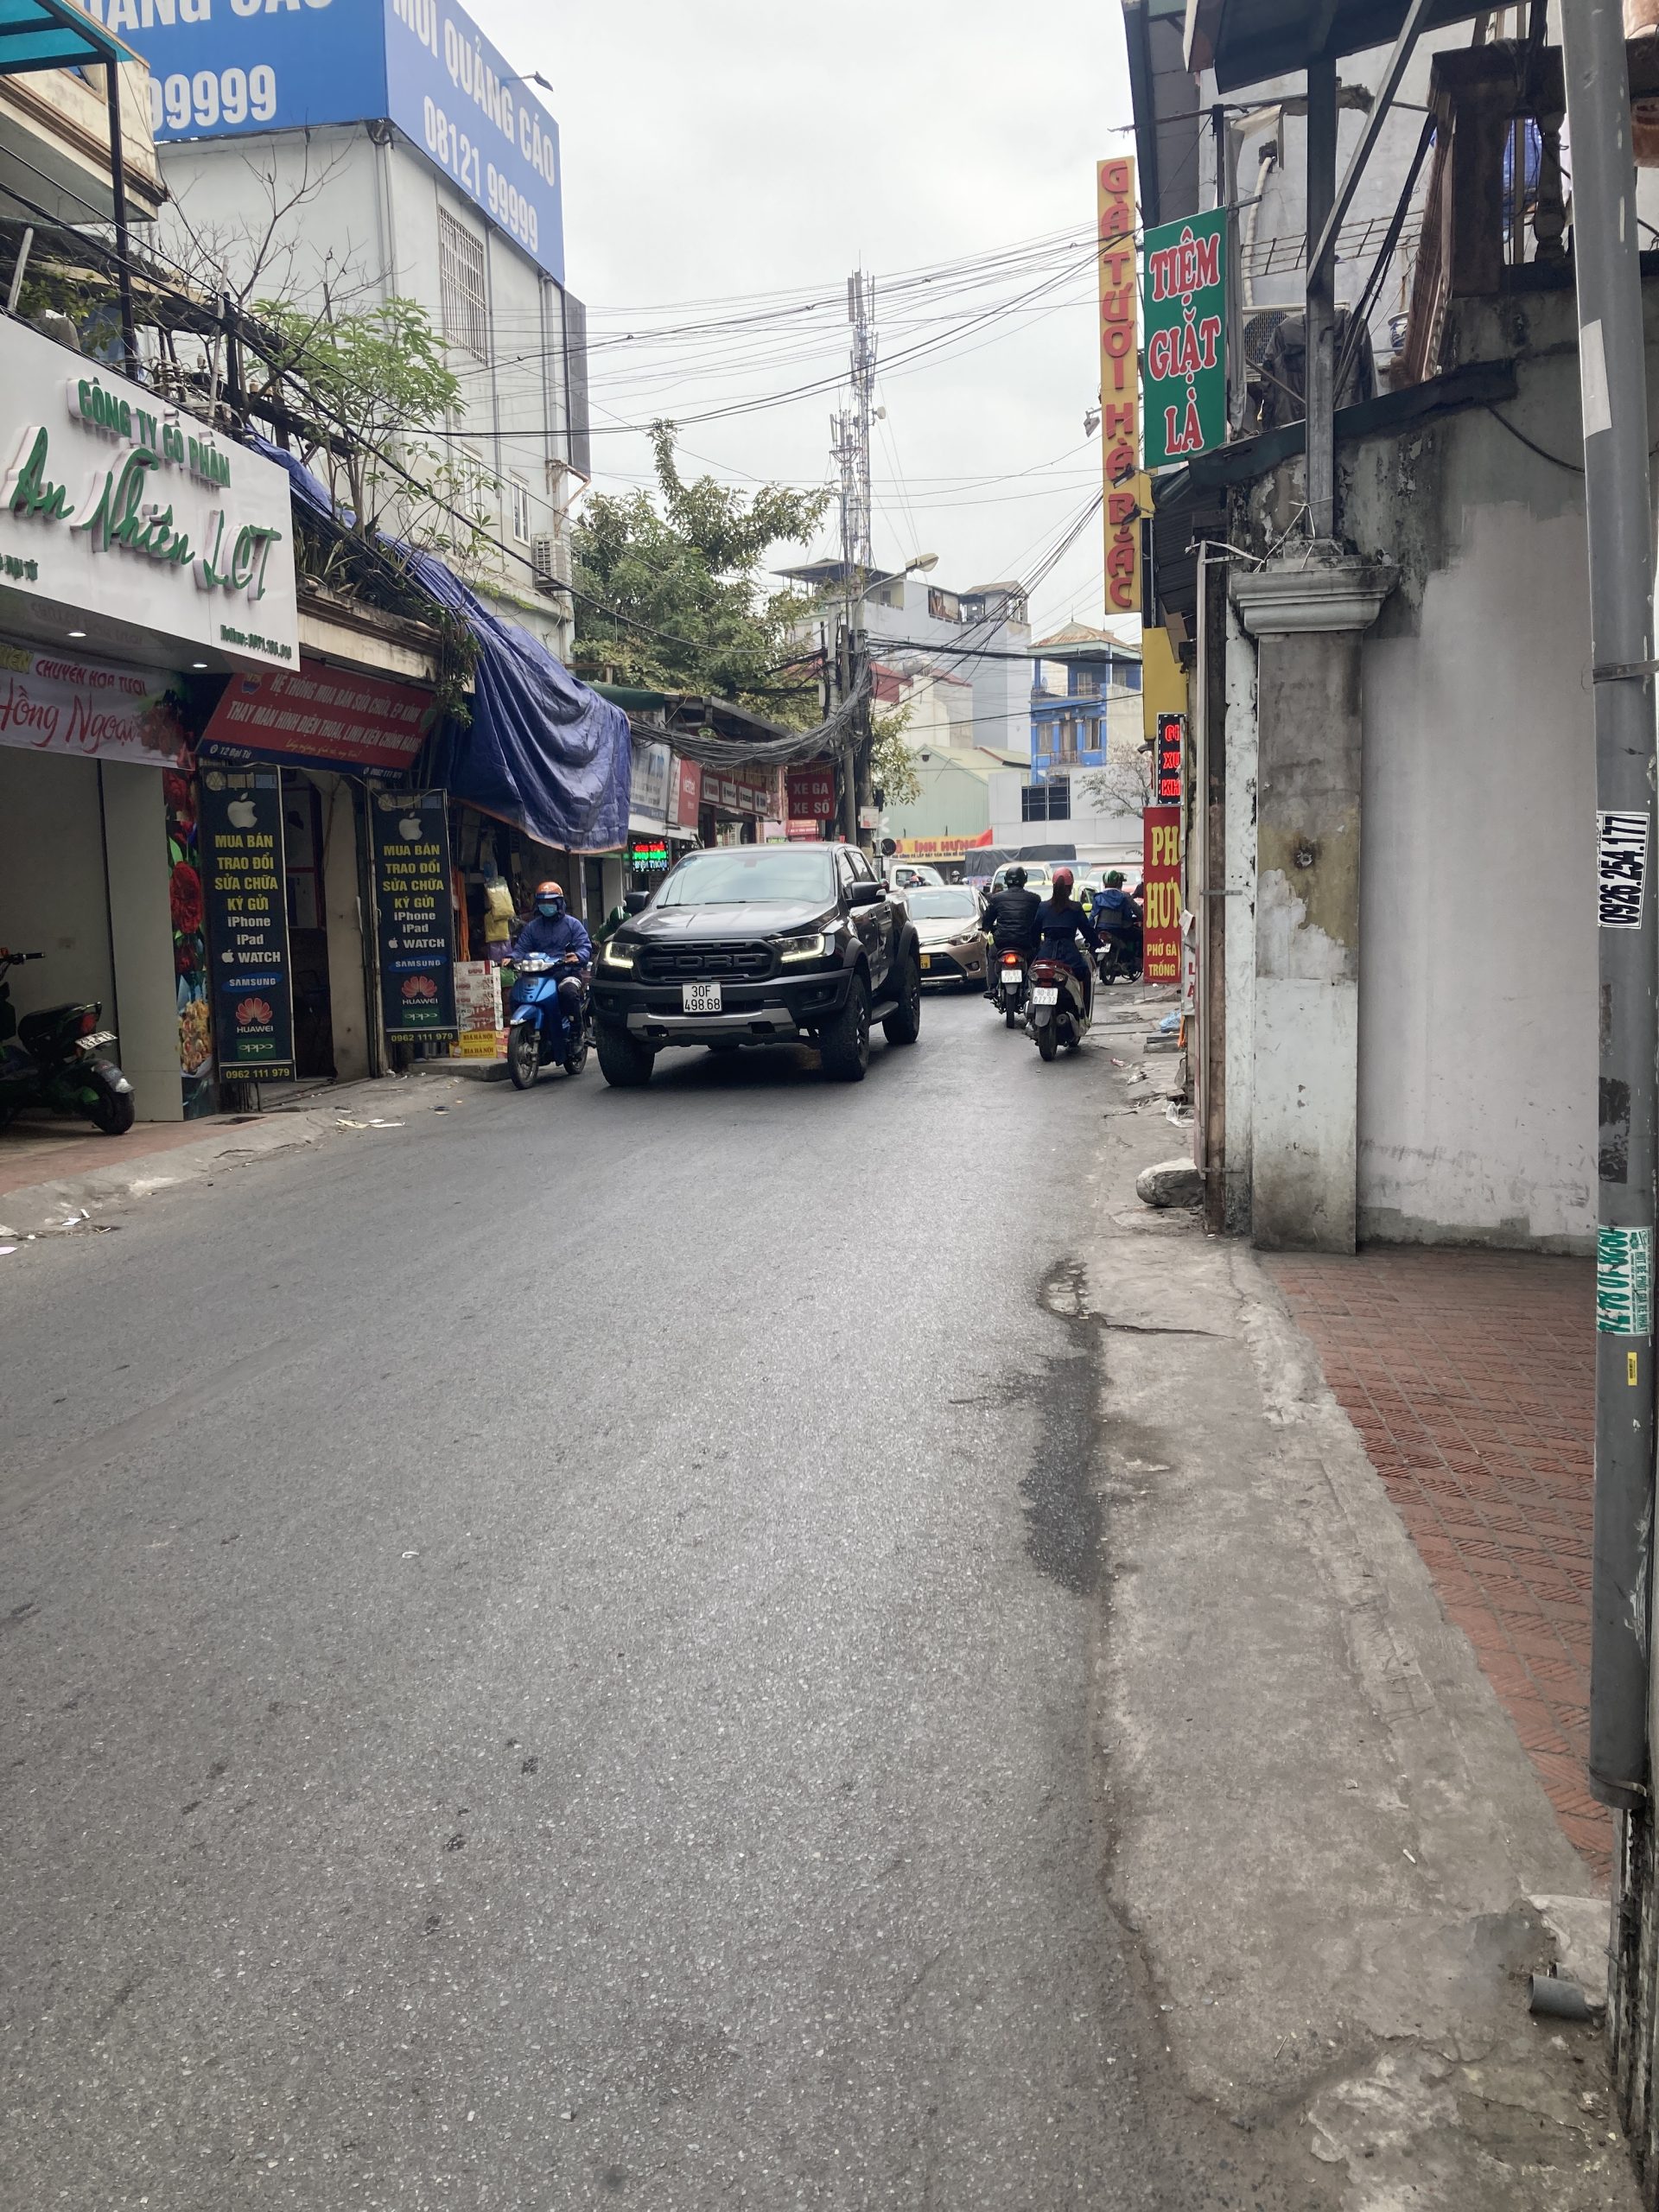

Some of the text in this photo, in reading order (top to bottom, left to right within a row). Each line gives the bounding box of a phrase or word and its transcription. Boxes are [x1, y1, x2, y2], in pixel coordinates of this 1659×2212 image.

[444, 18, 515, 145] QUẢNG
[518, 106, 555, 187] CÁO
[423, 95, 538, 253] 08121 99999
[1101, 160, 1129, 241] GÀ
[1148, 225, 1221, 307] TIỆM
[1102, 251, 1135, 390] TƯƠI
[1148, 307, 1221, 384] GIẶT
[1164, 387, 1205, 455] LÀ
[77, 377, 231, 488] CÔNG TY CỔ PHẦN
[8, 427, 75, 519] An
[81, 448, 196, 566] Nhiên
[1107, 493, 1135, 608] BẮC
[35, 659, 87, 684] CHUYÊN
[89, 671, 115, 689] HOA
[118, 676, 148, 696] TƯƠI
[270, 672, 286, 696] HỆ
[284, 675, 317, 700] THỐNG
[314, 685, 338, 704] MUA
[334, 686, 356, 709] BÁN
[352, 689, 372, 713] SỬA
[226, 701, 257, 722] THAY
[251, 704, 277, 728] MÀN
[274, 708, 300, 731] HÌNH
[297, 713, 322, 737] ĐIỆN
[363, 725, 381, 748] KIỆN
[219, 746, 229, 755] 12
[229, 747, 241, 759] Đại
[793, 782, 829, 795] XE GA
[793, 797, 830, 814] XE SỐ
[214, 832, 273, 848] MUA BÁN
[1151, 825, 1180, 867] PH
[383, 842, 440, 856] MUA BÁN
[216, 852, 274, 870] TRAO ĐỔI
[385, 859, 441, 874] TRAO ĐỔI
[1599, 816, 1646, 925] 0926.254.177
[214, 873, 278, 890] SỬA CHỮA
[383, 877, 444, 891] SỬA CHỮA
[226, 893, 269, 911] KÝ GỬI
[394, 894, 435, 908] KÝ GỬI
[227, 916, 271, 928] iPhone
[394, 912, 436, 921] iPhone
[402, 924, 429, 933] iPad
[237, 934, 264, 945] iPad
[403, 938, 445, 949] WATCH
[1147, 938, 1177, 957] PHỞ GÀ
[238, 951, 281, 963] WATCH
[395, 959, 442, 968] SAMSUNG
[648, 953, 765, 968] FORD
[1147, 959, 1176, 976] TRỐNG
[228, 977, 276, 987] SAMSUNG
[691, 985, 711, 998] 30F
[684, 999, 721, 1011] 498.68
[236, 1025, 274, 1034] HUAWEI
[226, 1068, 290, 1079] 0962 111 979
